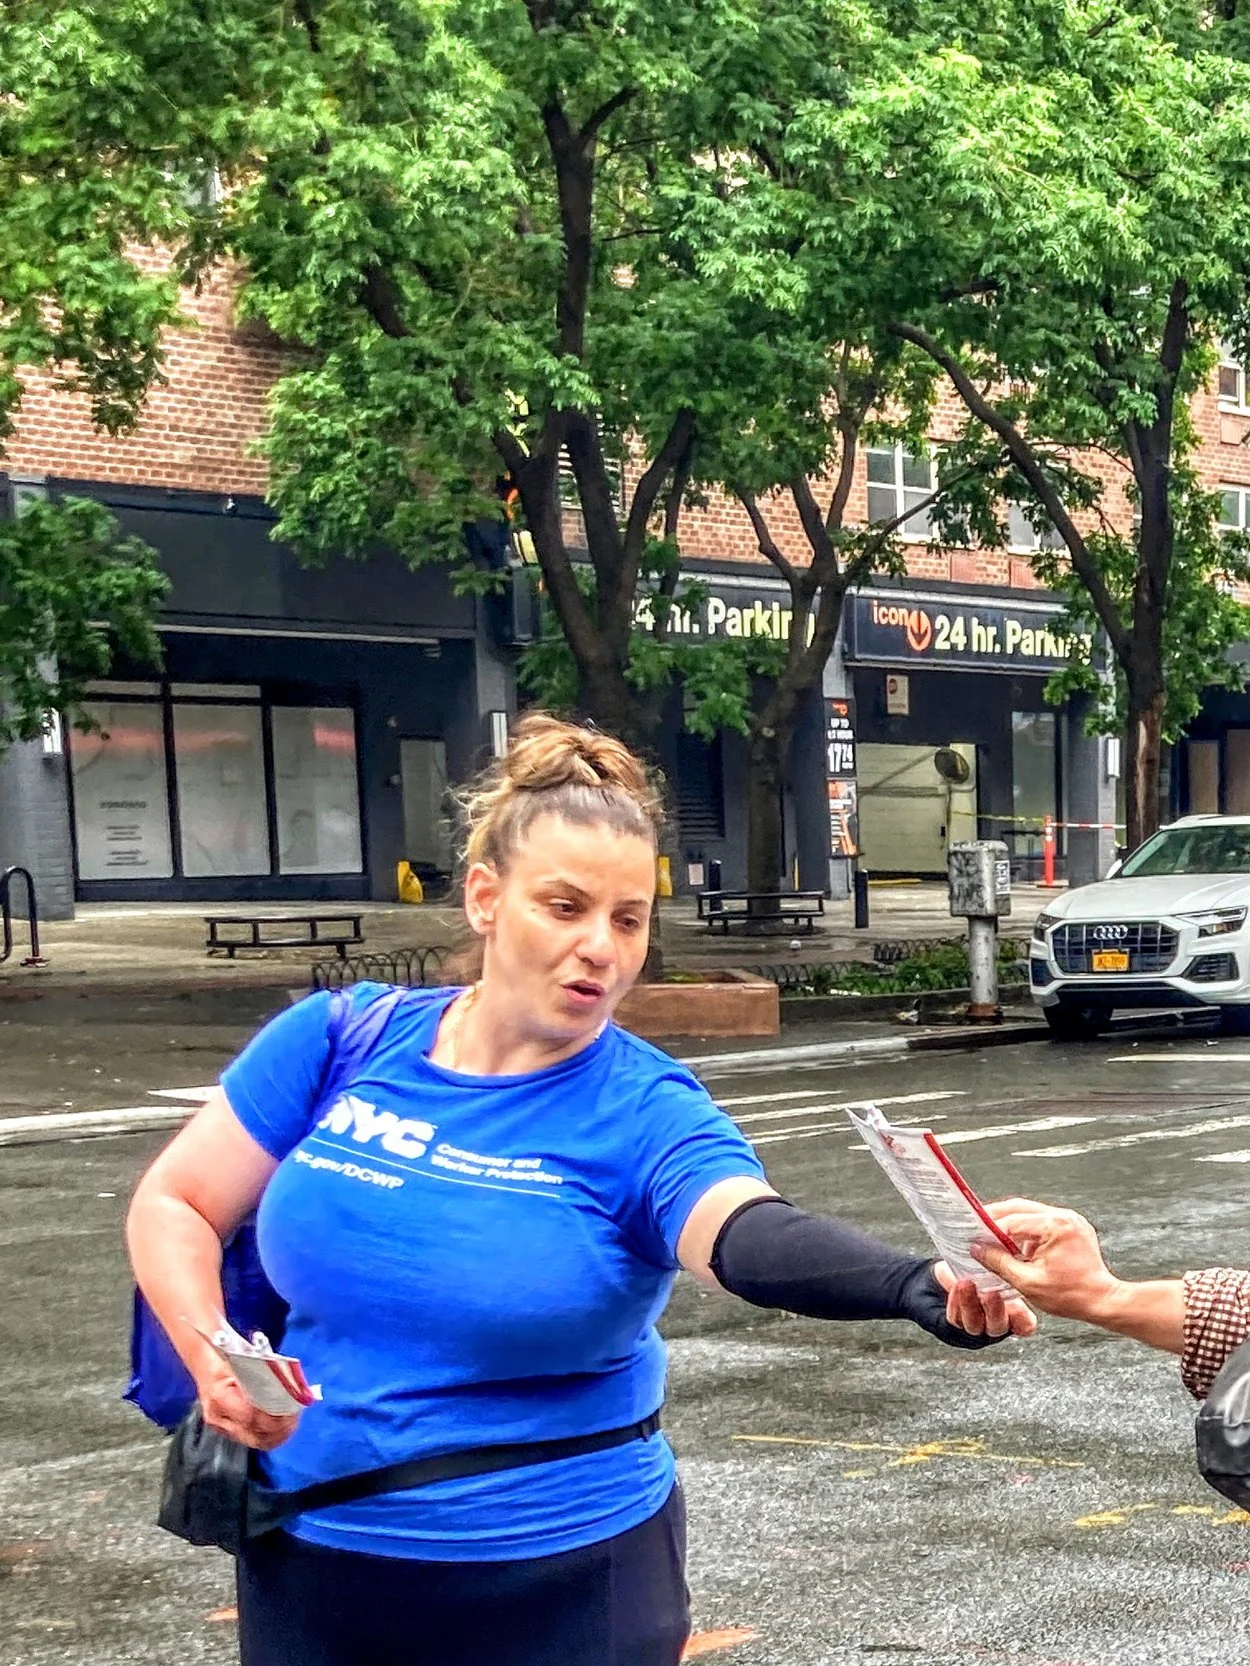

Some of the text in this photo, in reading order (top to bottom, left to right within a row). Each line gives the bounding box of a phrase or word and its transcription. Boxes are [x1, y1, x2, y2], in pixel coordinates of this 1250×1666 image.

[872, 600, 909, 625] icon
[934, 616, 968, 651] 24
[971, 617, 1001, 653] hr.
[317, 1091, 436, 1160] NYC
